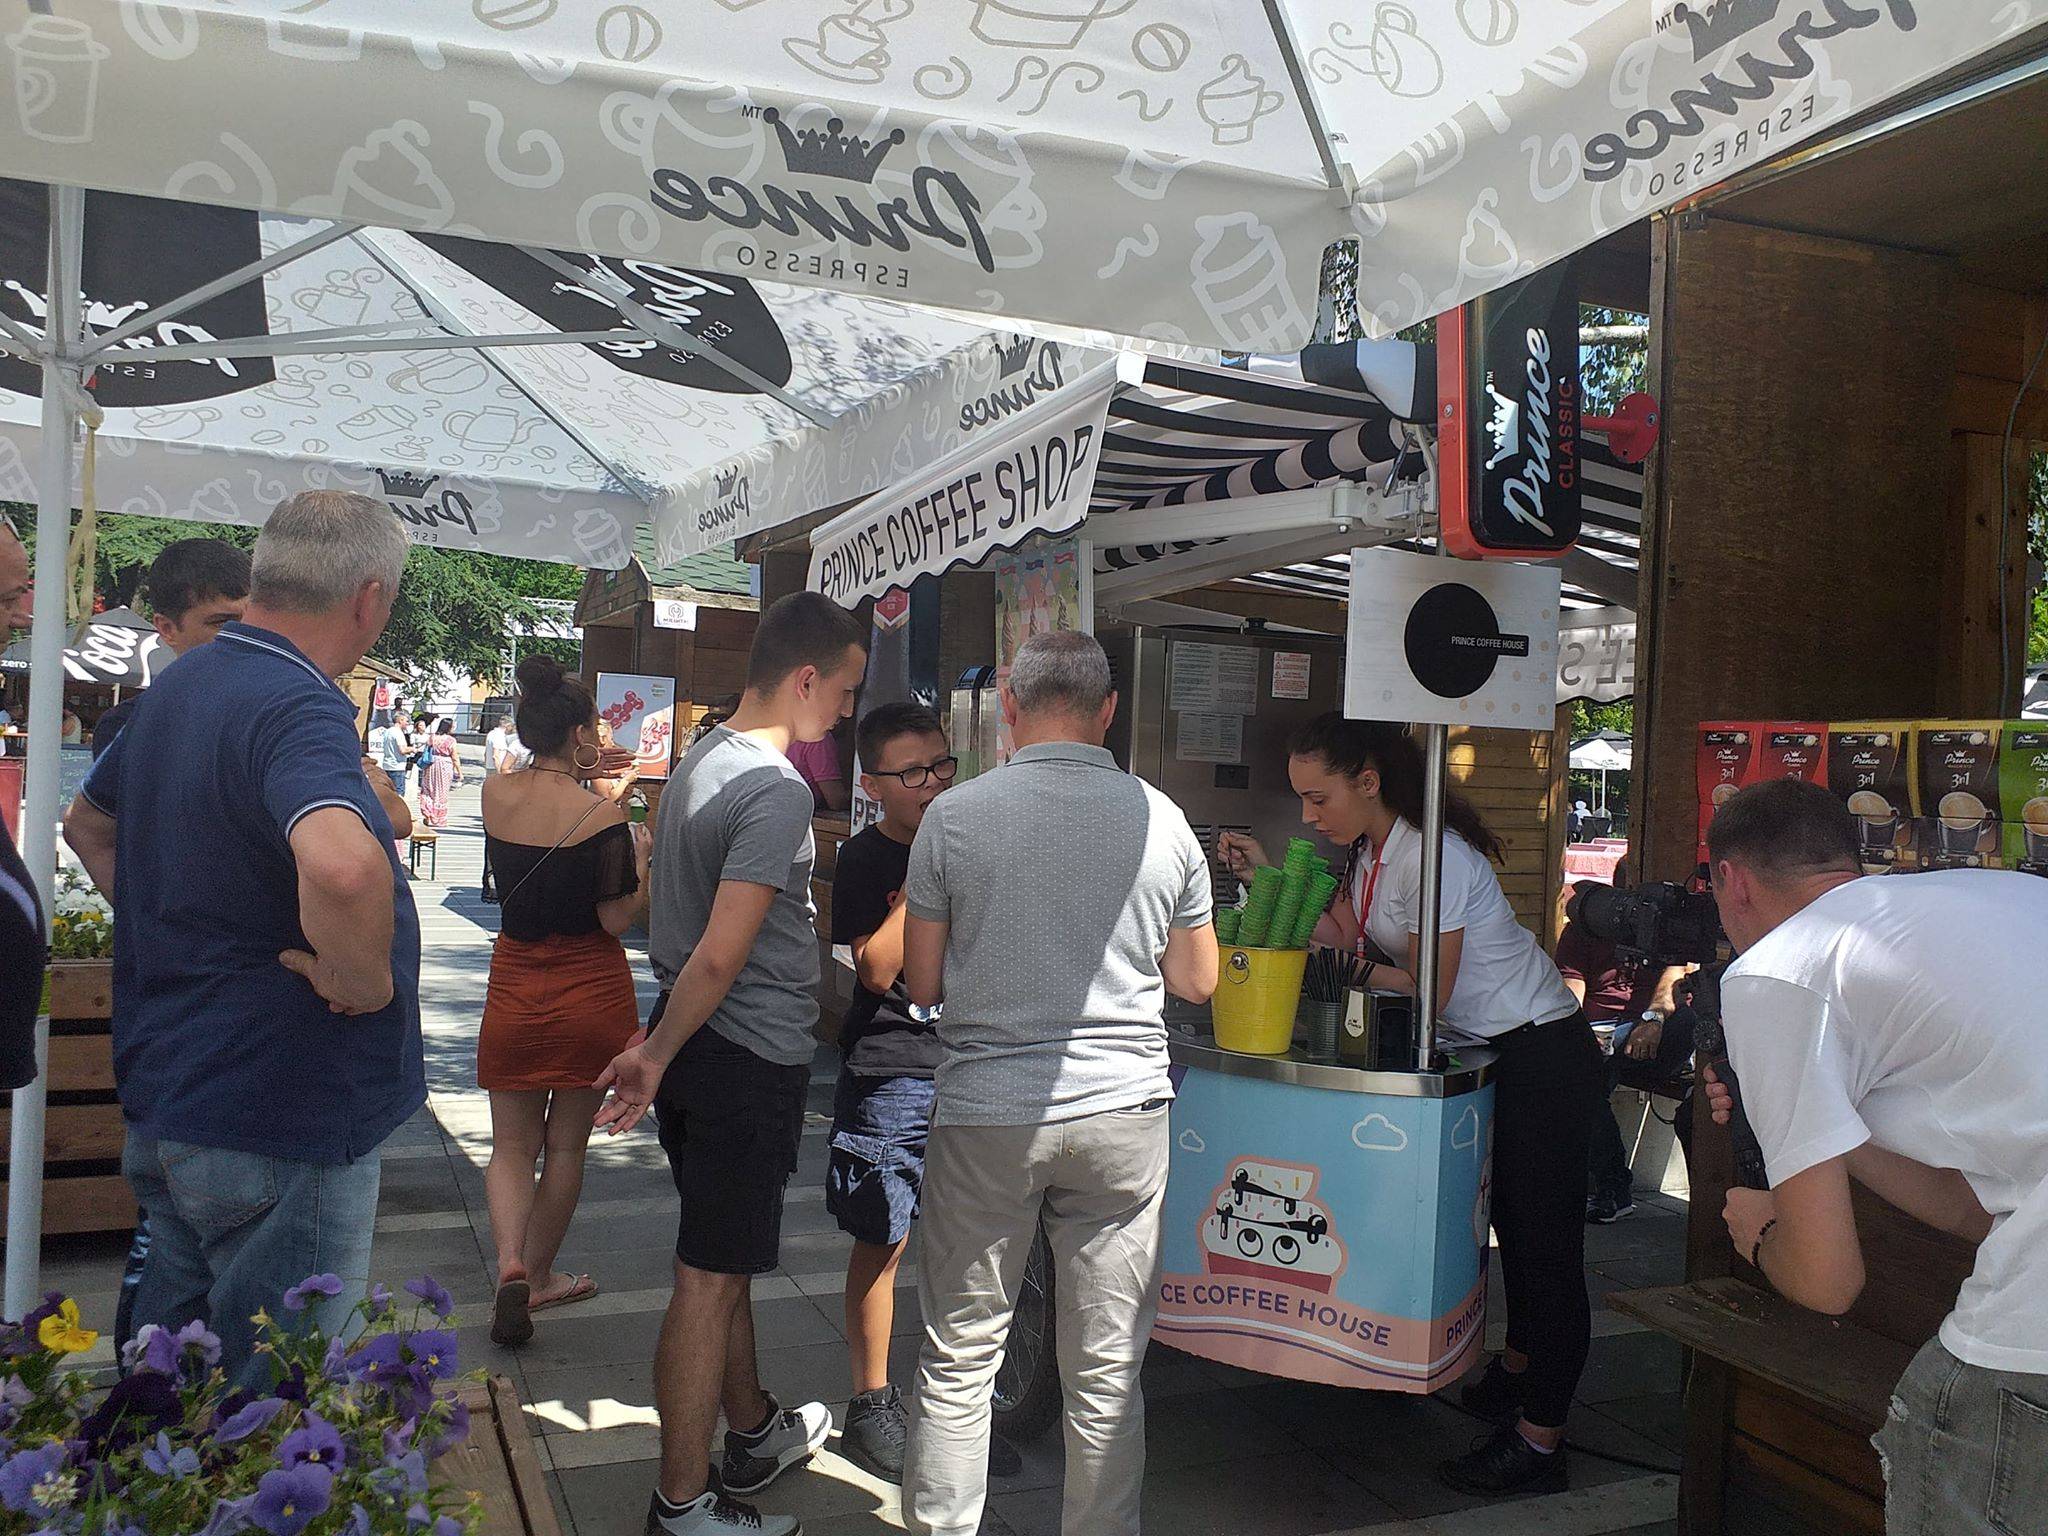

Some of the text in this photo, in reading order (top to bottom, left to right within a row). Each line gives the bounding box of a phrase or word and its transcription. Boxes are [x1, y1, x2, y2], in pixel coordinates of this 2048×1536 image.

[1503, 327, 1554, 537] Prince
[1558, 383, 1575, 489] CLASSIC
[821, 424, 1094, 599] PRINCE COFFEE SHOP
[0, 659, 28, 669] zero
[1451, 636, 1525, 649] PRINCE COFFEE HOUSE
[1851, 754, 1880, 764] Prince
[1944, 753, 1976, 764] Prince
[1193, 1284, 1289, 1315] COFFEE
[1298, 1299, 1392, 1347] HOUSE
[1446, 1290, 1484, 1347] PRINCE
